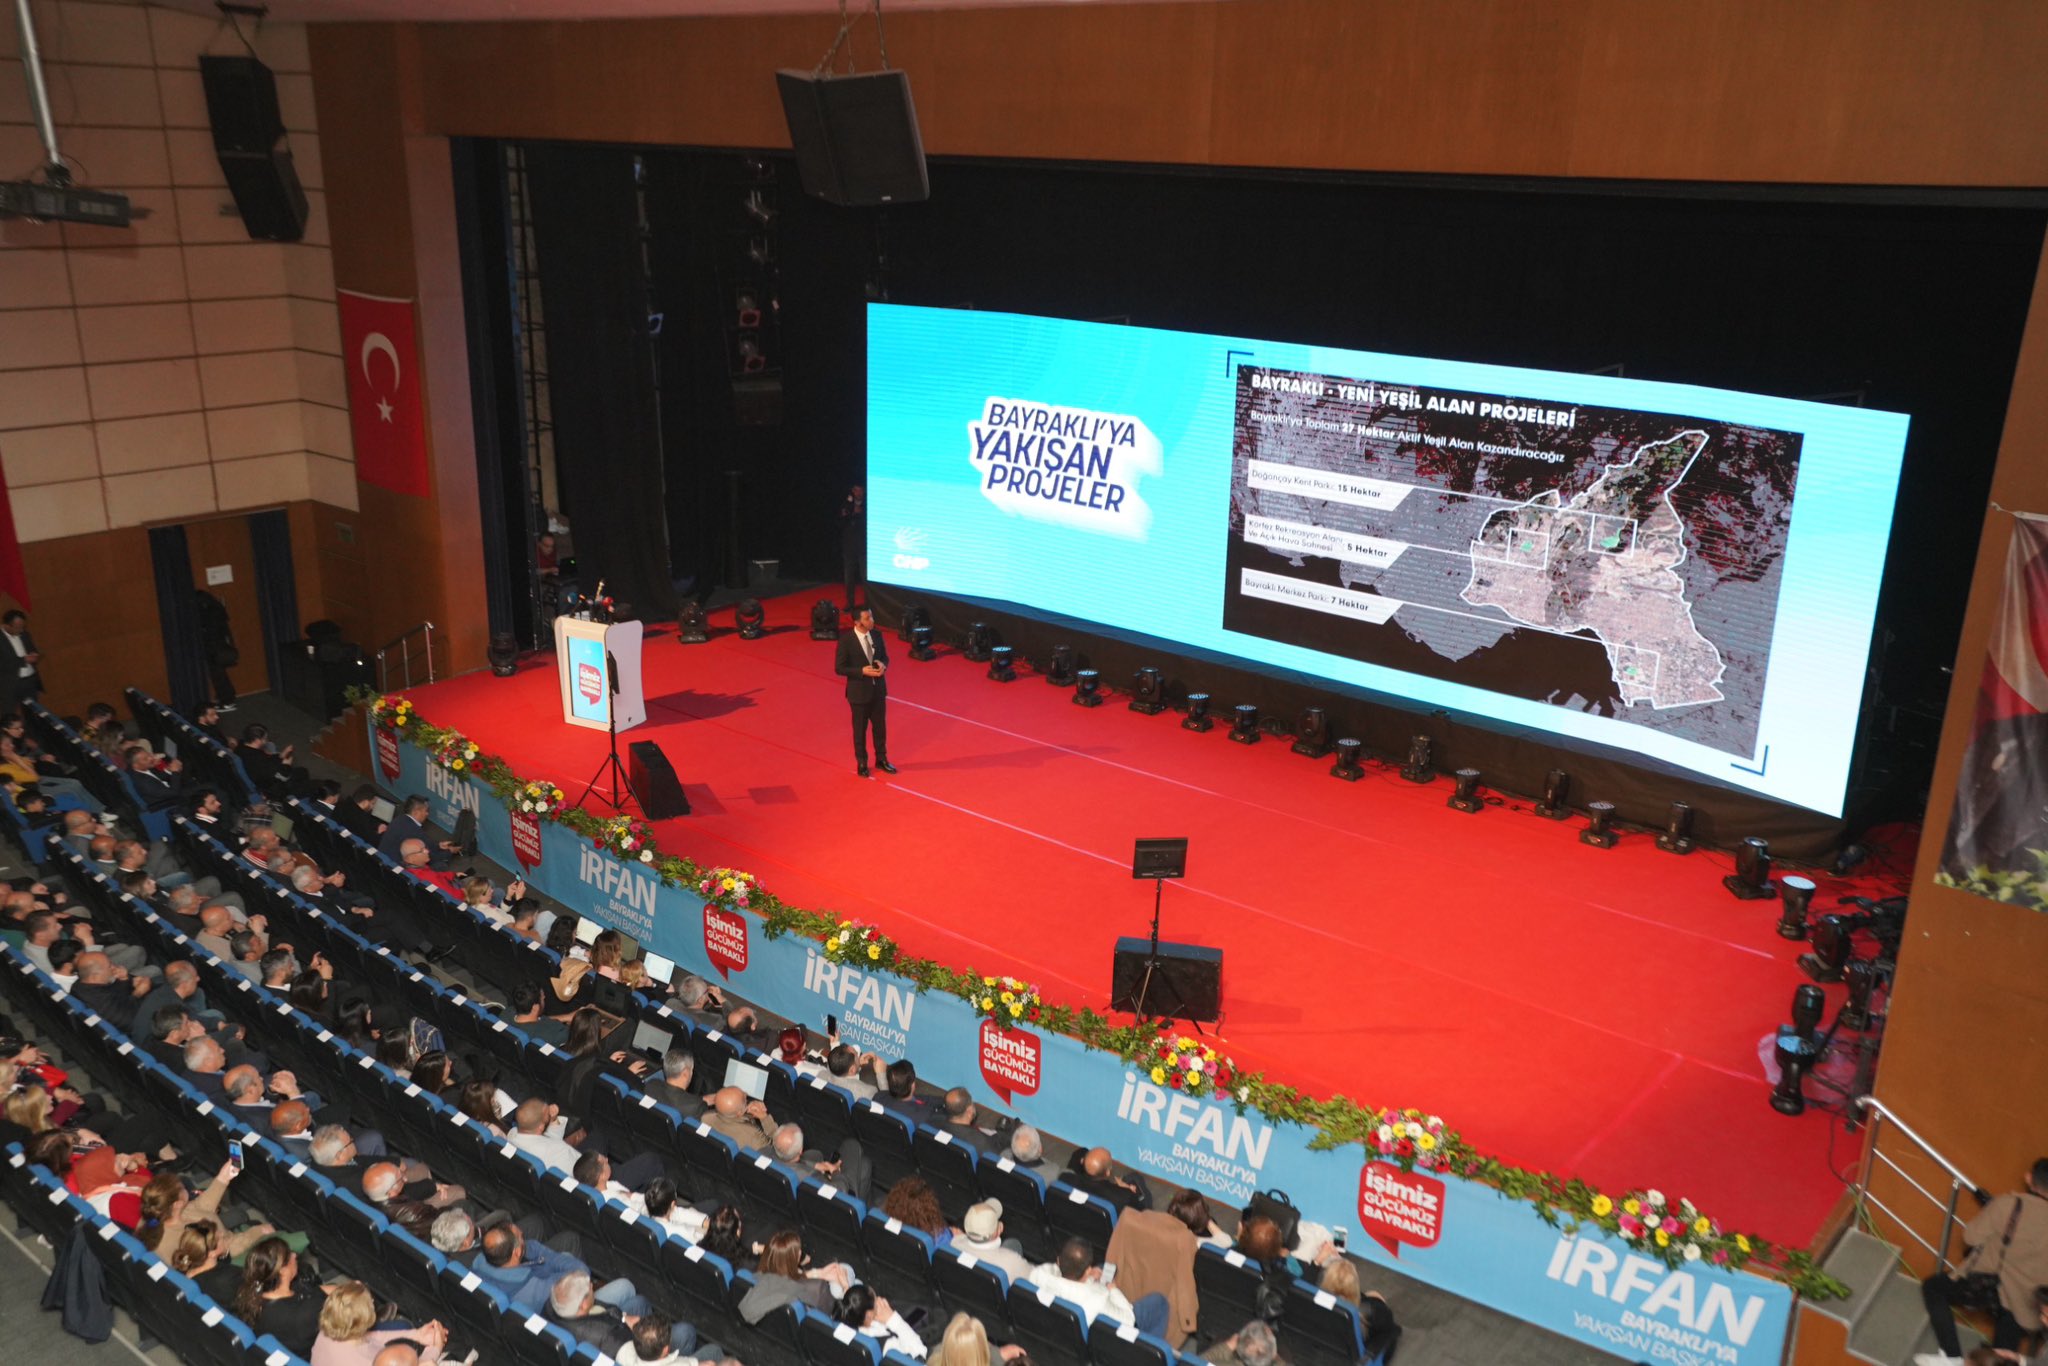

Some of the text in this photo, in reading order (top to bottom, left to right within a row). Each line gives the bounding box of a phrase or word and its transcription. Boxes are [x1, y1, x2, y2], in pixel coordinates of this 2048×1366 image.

[1252, 374, 1323, 396] BAYRAKLI
[1337, 384, 1374, 402] YENİ
[1380, 388, 1422, 411] YEŞİL
[1426, 396, 1474, 415] ALAN
[1480, 402, 1577, 427] PROJELERİ
[988, 404, 1136, 447] BAYRAKLI'YA
[1305, 418, 1339, 433] Toplam
[1342, 422, 1354, 433] 27
[1358, 425, 1396, 439] Hektar
[1398, 430, 1421, 442] Aktif
[1423, 434, 1446, 448] Yeşil
[1450, 437, 1473, 450] Alan
[1477, 441, 1565, 464] Kazandıracağız
[974, 427, 1113, 479] YAKIŞAN
[987, 464, 1125, 513] PROJELER
[1252, 469, 1292, 484] Doğançay
[1294, 476, 1312, 486] Kent
[1338, 484, 1347, 492] 15
[1351, 486, 1382, 498] Hektar
[1278, 534, 1300, 545] Hava
[1347, 543, 1353, 551] 5
[1355, 544, 1389, 558] Hektar
[1278, 585, 1306, 597] Merkez
[1331, 596, 1336, 604] 7
[1339, 598, 1369, 612] Hektar
[706, 909, 744, 941] işimiz
[707, 930, 744, 953] GÜCÜMÜZ
[707, 940, 745, 964] BAYRAKLI
[845, 1010, 906, 1047] BAYRAKLI'YA
[862, 1033, 905, 1059] BAŞKAN
[984, 1025, 1036, 1062] işimiz
[983, 1047, 1036, 1076] GÜCÜMÜZ
[983, 1059, 1036, 1088] BAYRAKLI
[1138, 1146, 1254, 1201] YAKIŞAN BAŞKAN
[1172, 1143, 1257, 1186] BAYRAKLI'YA
[1366, 1166, 1438, 1211] işimiz
[1363, 1203, 1435, 1240] BAYRAKLI
[1364, 1191, 1436, 1227] GÜCÜMÜZ
[1573, 1310, 1650, 1352] YAKIŞAN
[1620, 1310, 1738, 1364] BAYRAKLI'YA
